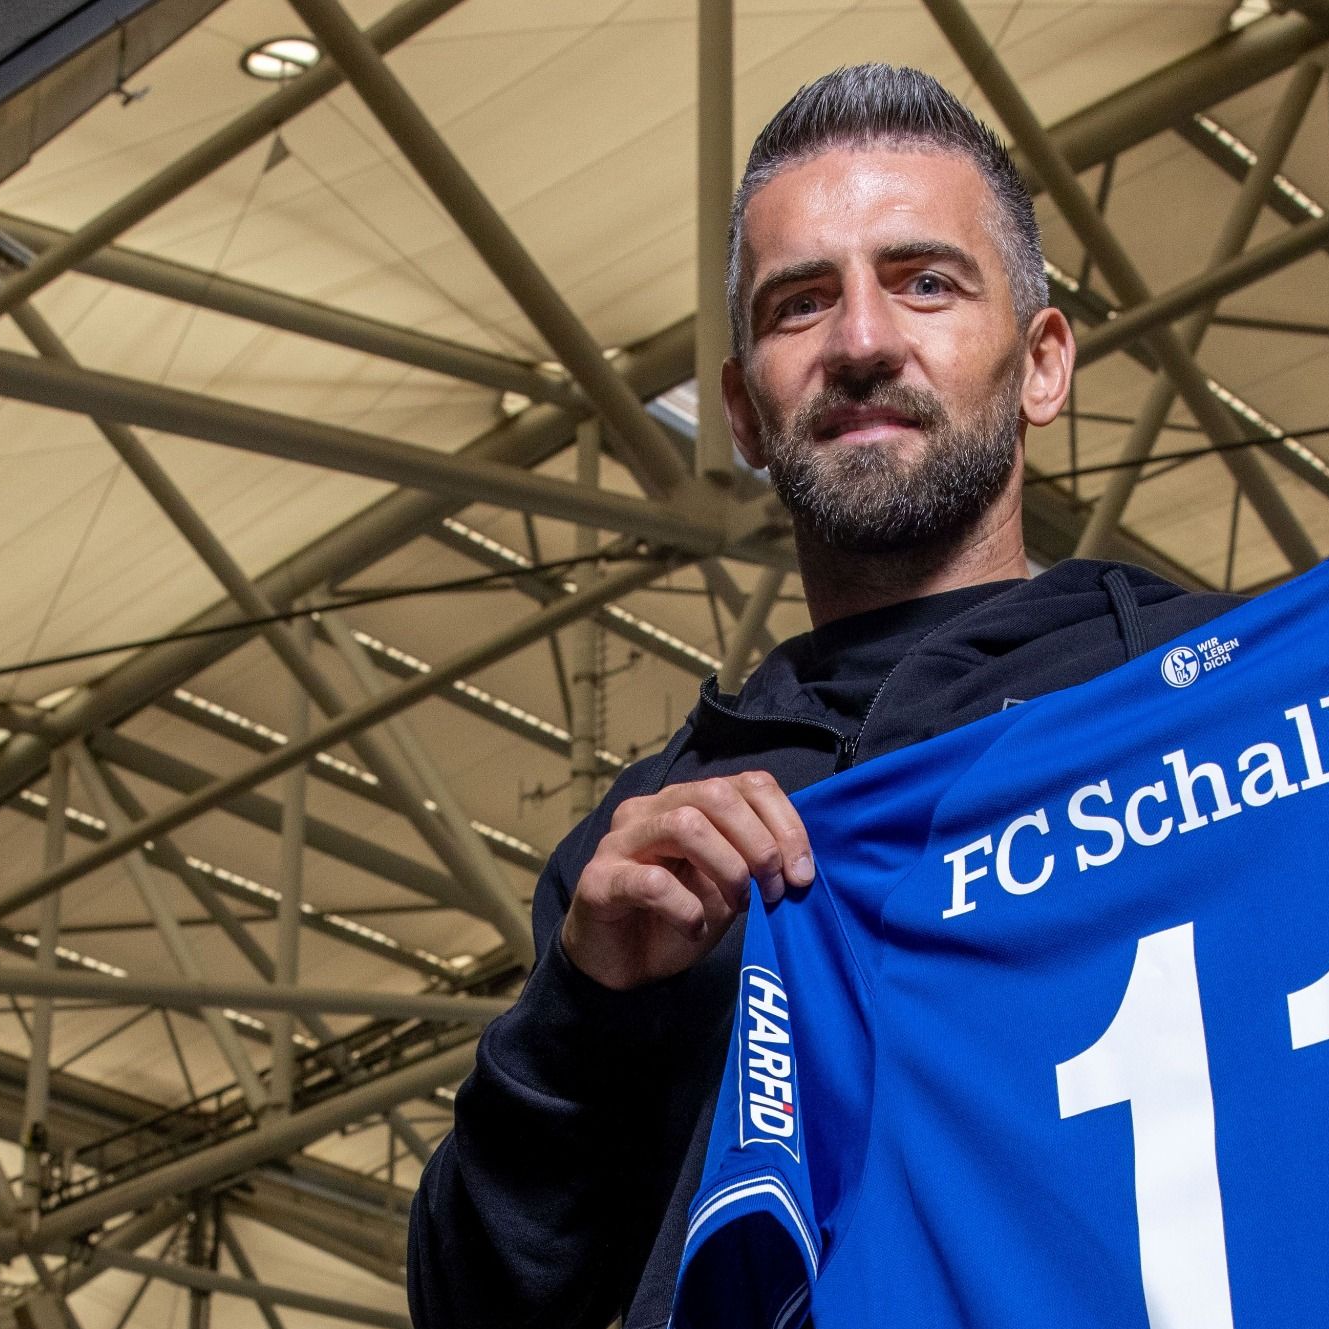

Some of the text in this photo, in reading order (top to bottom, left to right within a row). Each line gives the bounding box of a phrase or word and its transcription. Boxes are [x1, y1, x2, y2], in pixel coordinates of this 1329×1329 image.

[1197, 637, 1220, 653] WIR
[1204, 638, 1240, 660] LEBEN
[1203, 653, 1232, 672] DICH
[942, 807, 1055, 919] FC
